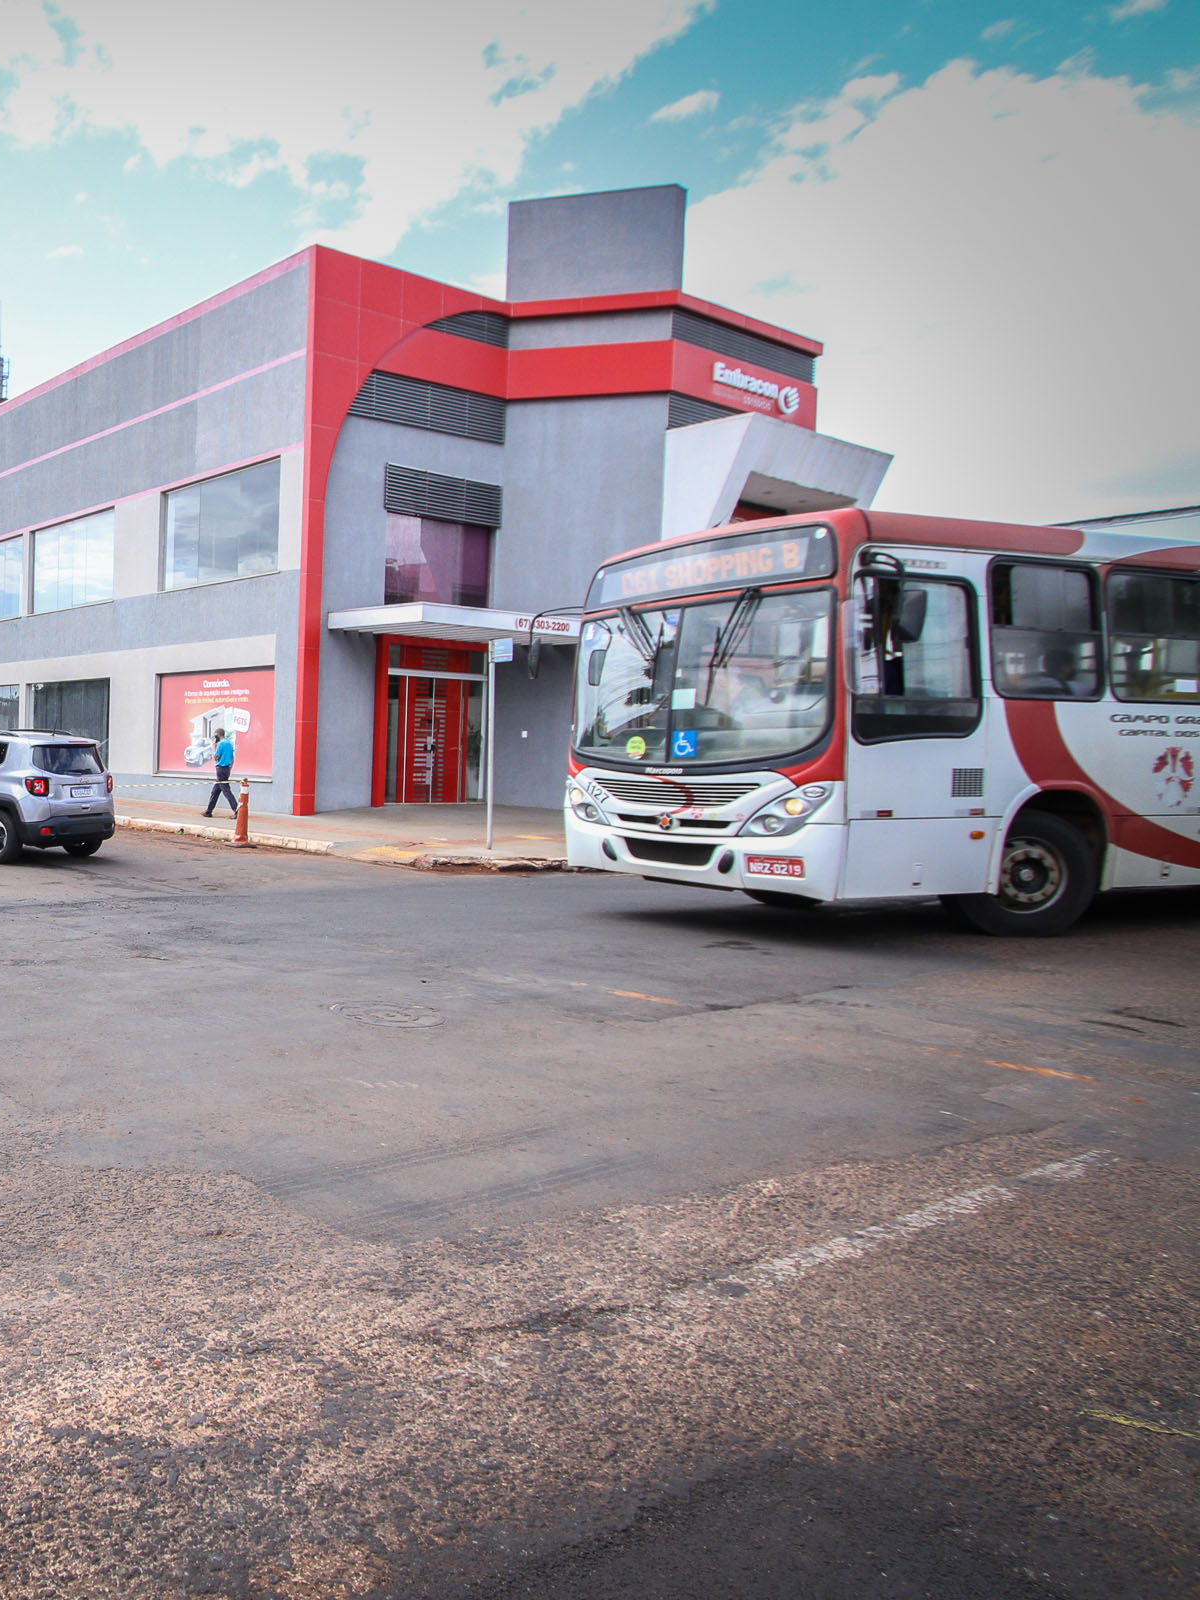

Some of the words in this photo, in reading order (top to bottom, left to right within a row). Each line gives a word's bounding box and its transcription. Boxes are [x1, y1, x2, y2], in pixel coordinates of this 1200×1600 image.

[713, 361, 779, 399] Embracon
[664, 547, 774, 587] SHOPPING
[782, 542, 801, 568] B
[532, 619, 570, 632] 303-2200
[234, 716, 247, 727] FGTS
[644, 766, 684, 775] Marcopolo
